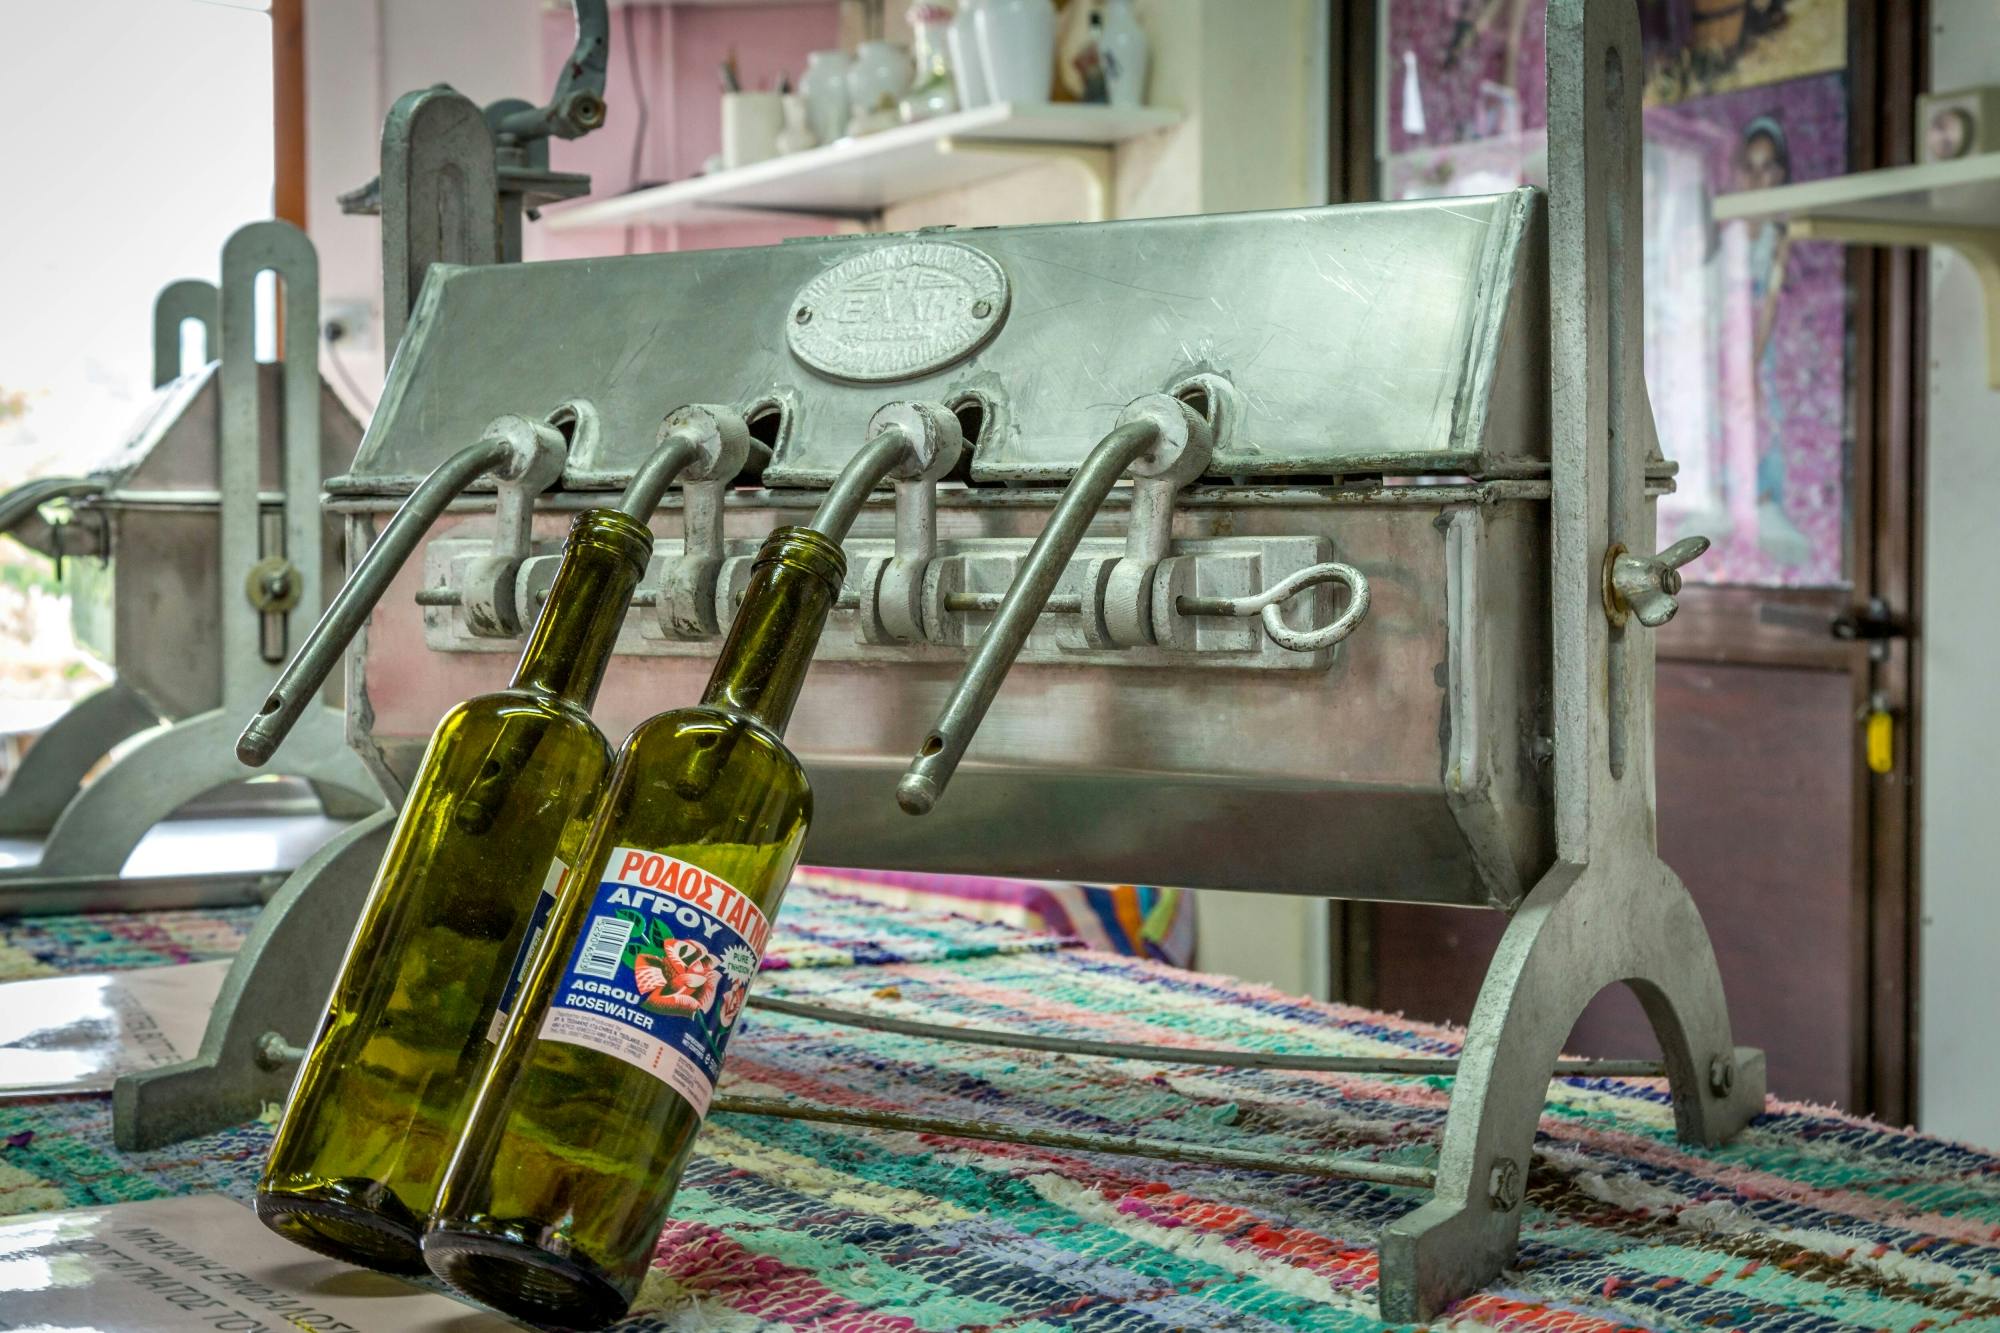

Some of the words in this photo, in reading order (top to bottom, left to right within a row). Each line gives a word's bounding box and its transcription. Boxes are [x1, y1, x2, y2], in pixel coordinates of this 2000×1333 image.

[607, 887, 722, 939] ΑΓΡΟΥ
[733, 953, 750, 964] PURE
[571, 979, 640, 1004] AGROU
[565, 993, 654, 1030] ROSEWATER
[112, 1228, 228, 1270] ΜΗΧΑΝΗ
[202, 1272, 361, 1333] ΕΜΦΙΑΛΩΣ
